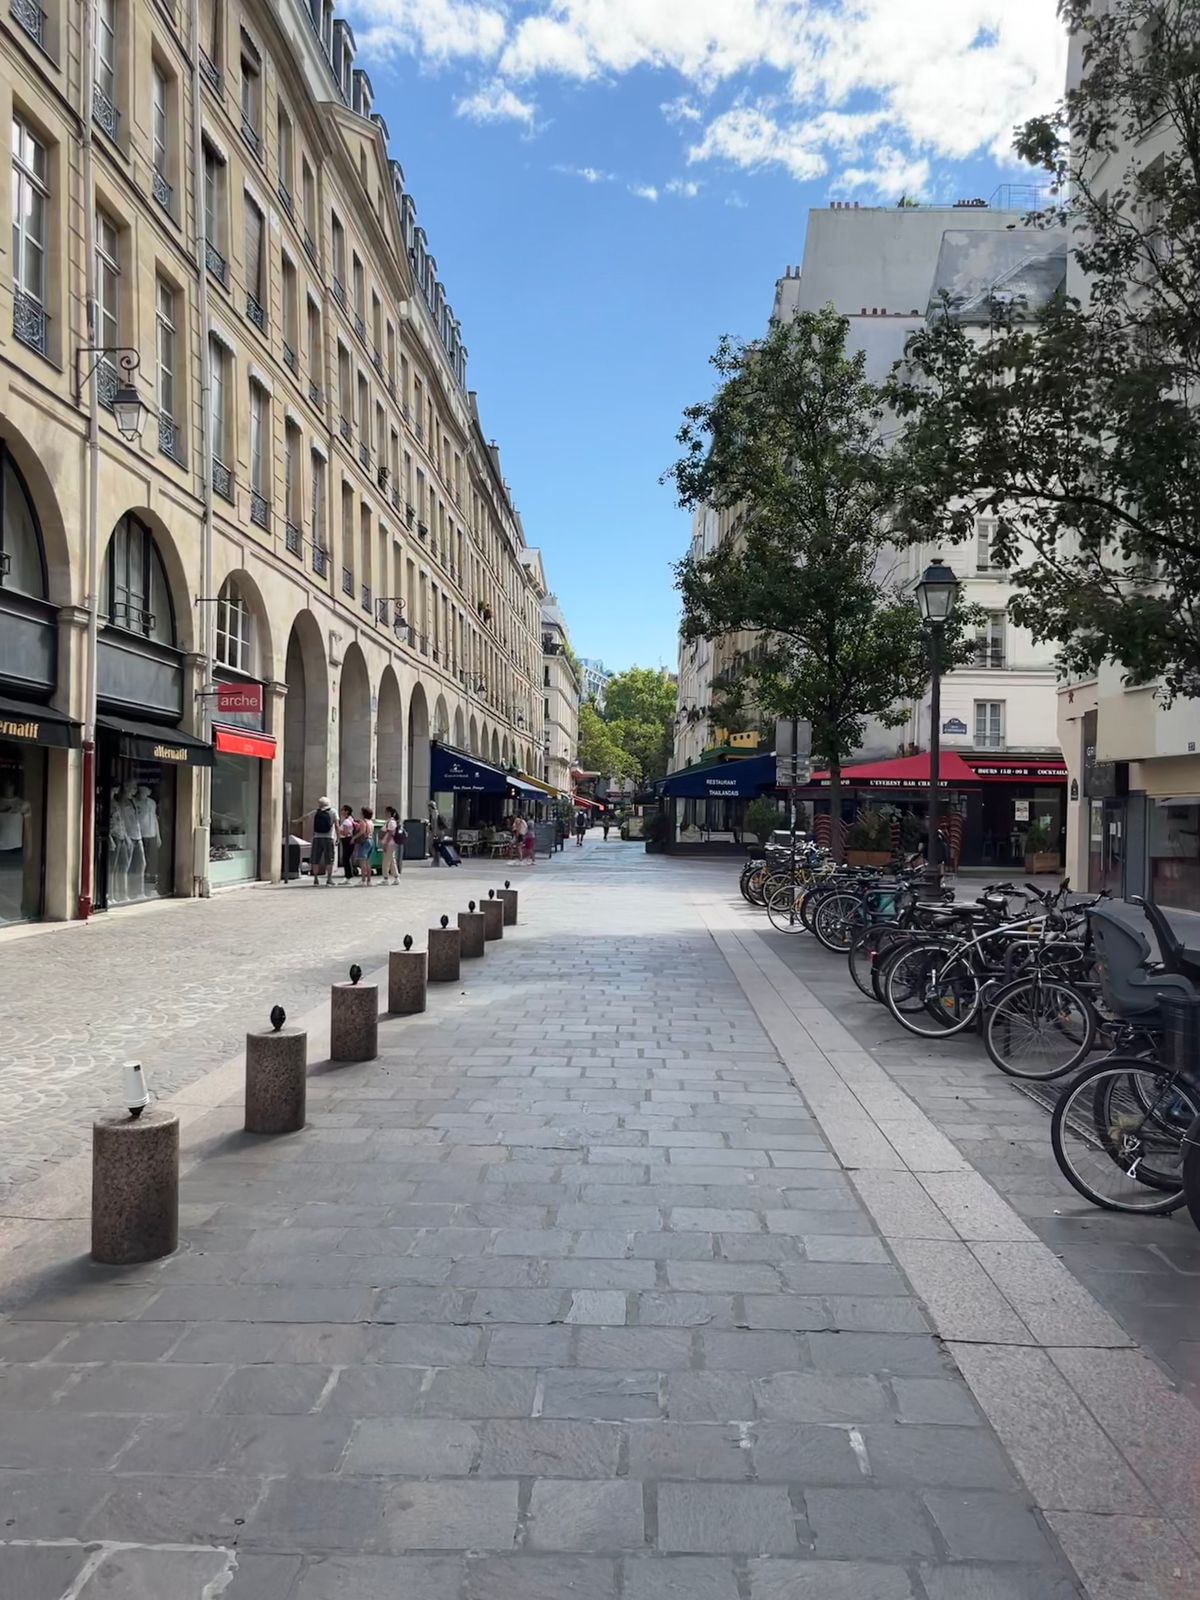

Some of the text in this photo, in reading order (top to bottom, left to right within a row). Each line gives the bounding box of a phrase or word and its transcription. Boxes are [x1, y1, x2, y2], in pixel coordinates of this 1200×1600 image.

[220, 695, 258, 707] arche
[153, 744, 188, 761] alternatif
[706, 778, 737, 786] RESTAURANT
